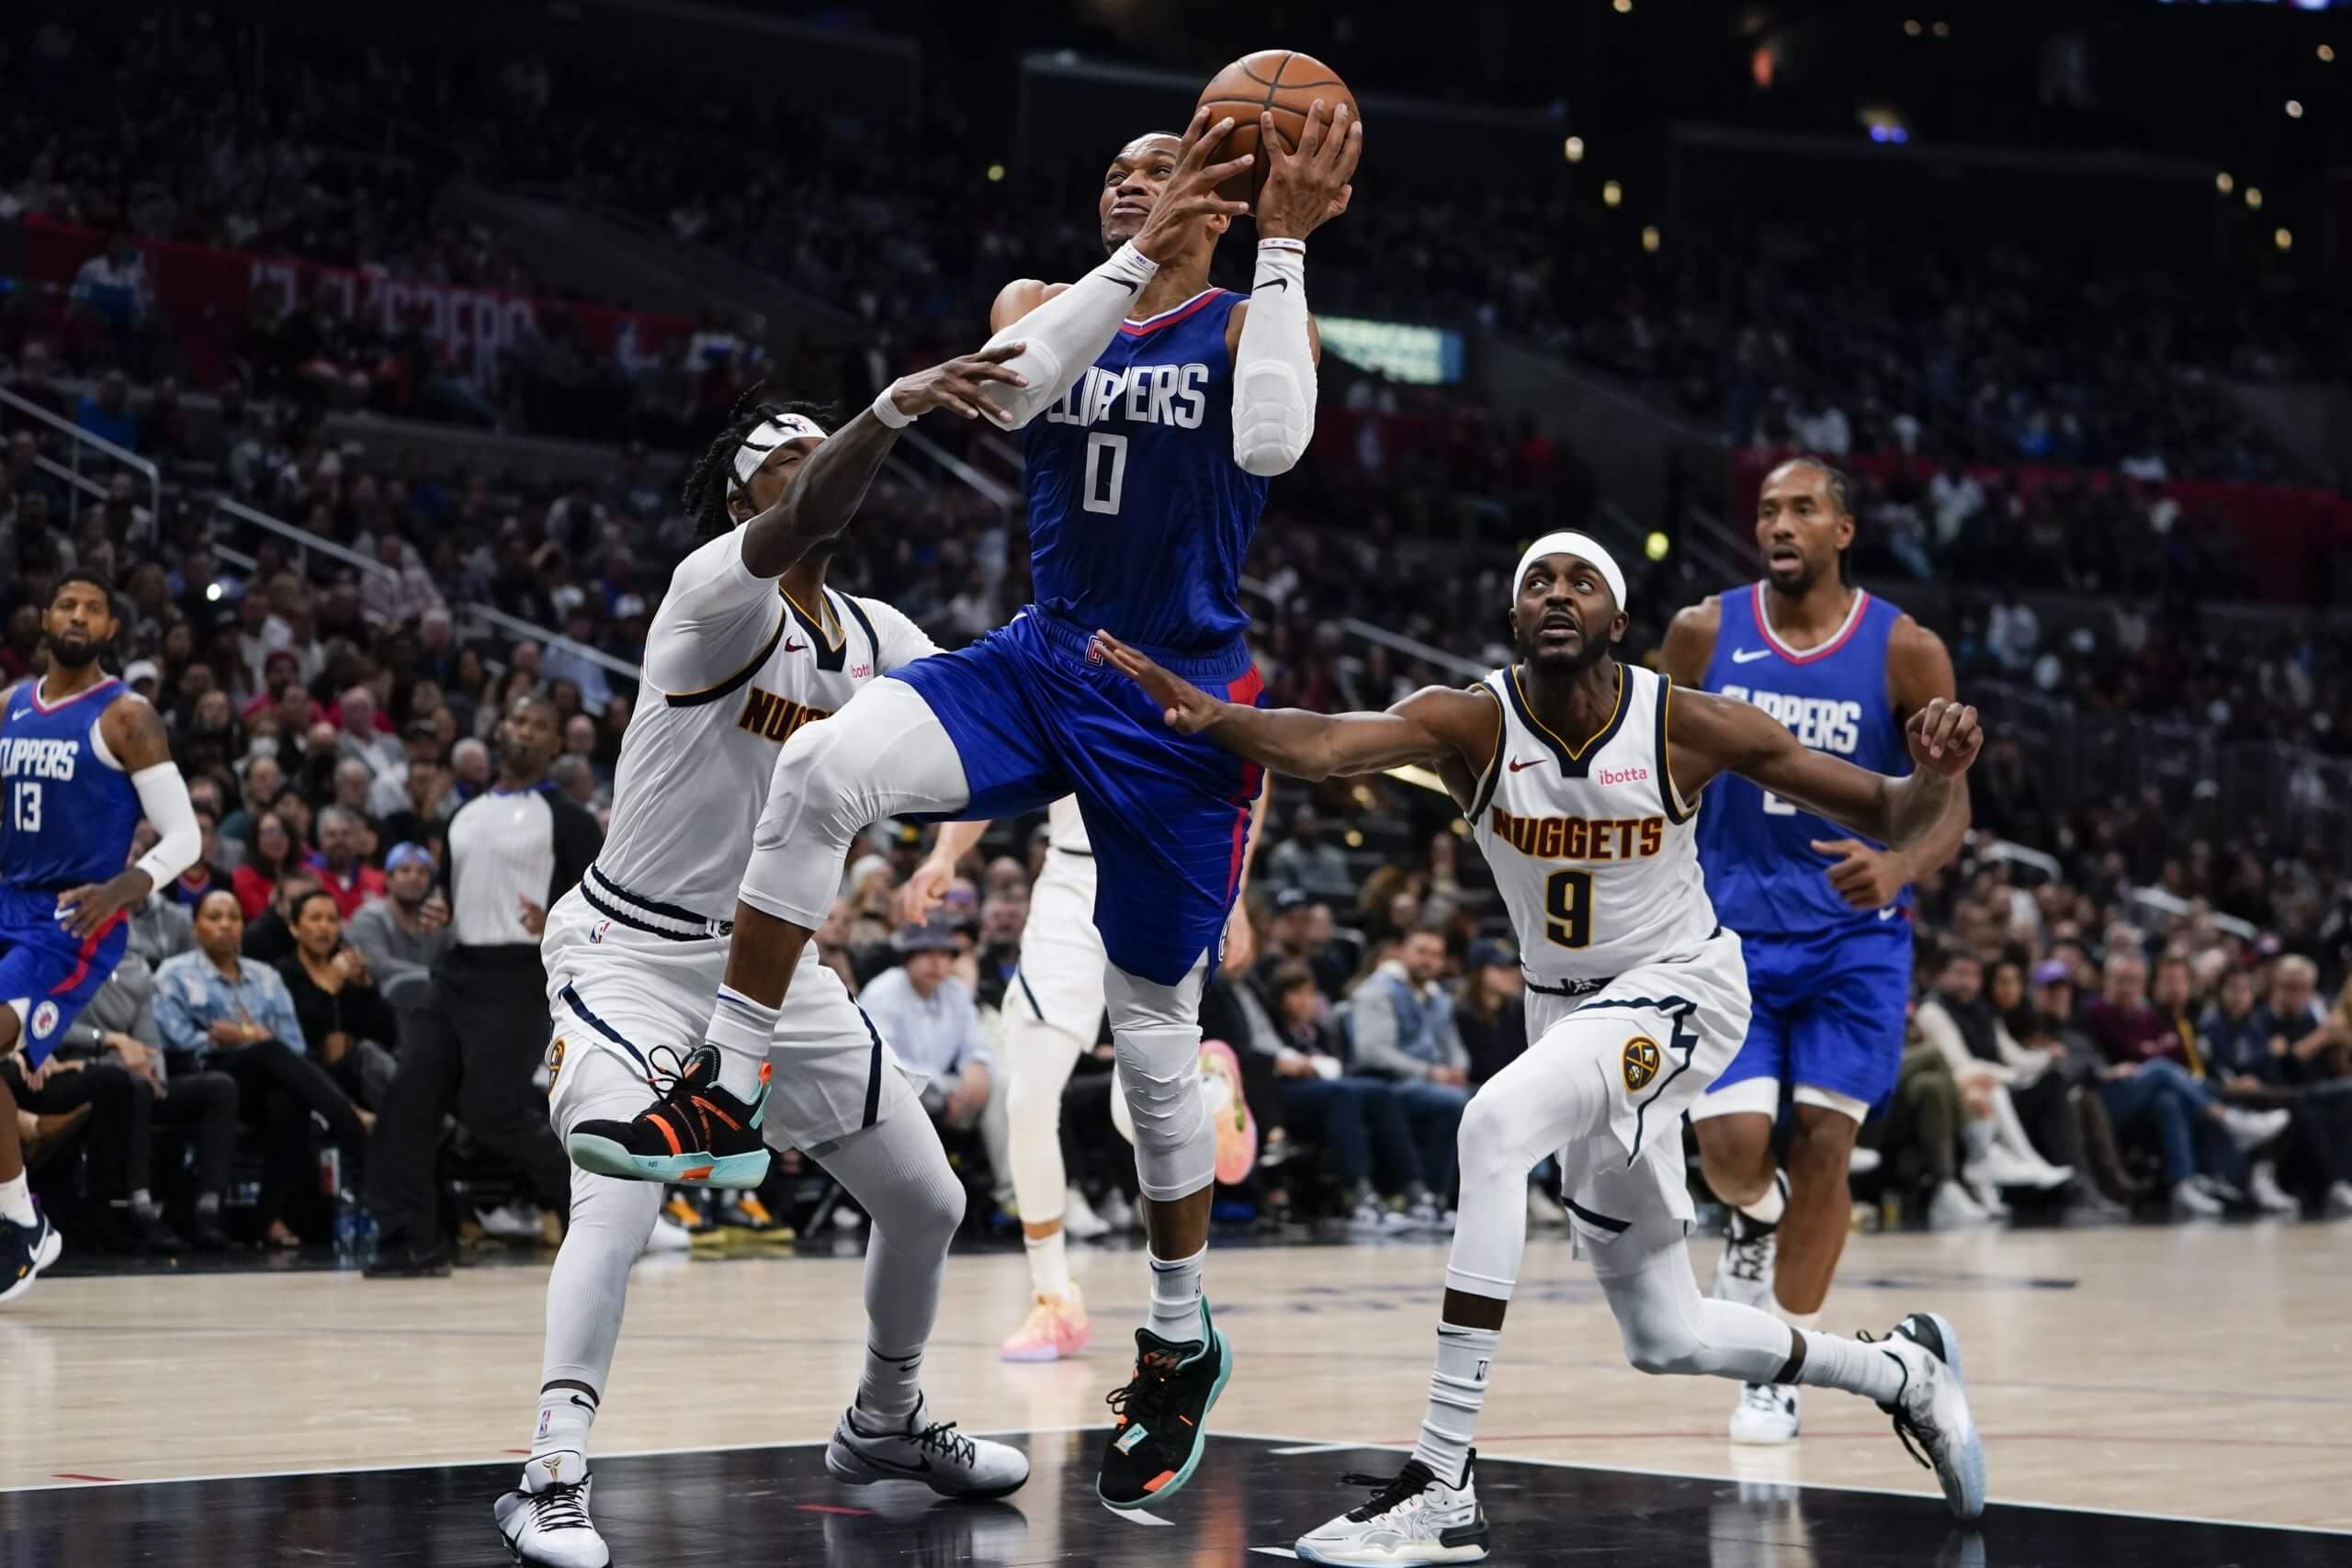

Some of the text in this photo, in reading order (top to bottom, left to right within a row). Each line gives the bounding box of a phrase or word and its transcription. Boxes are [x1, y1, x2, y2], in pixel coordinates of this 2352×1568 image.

[1082, 432, 1128, 515] 0
[1599, 768, 1647, 785] ibotta
[15, 782, 41, 832] 13
[1491, 806, 1664, 861] NUGGETS
[1545, 868, 1595, 952] 9
